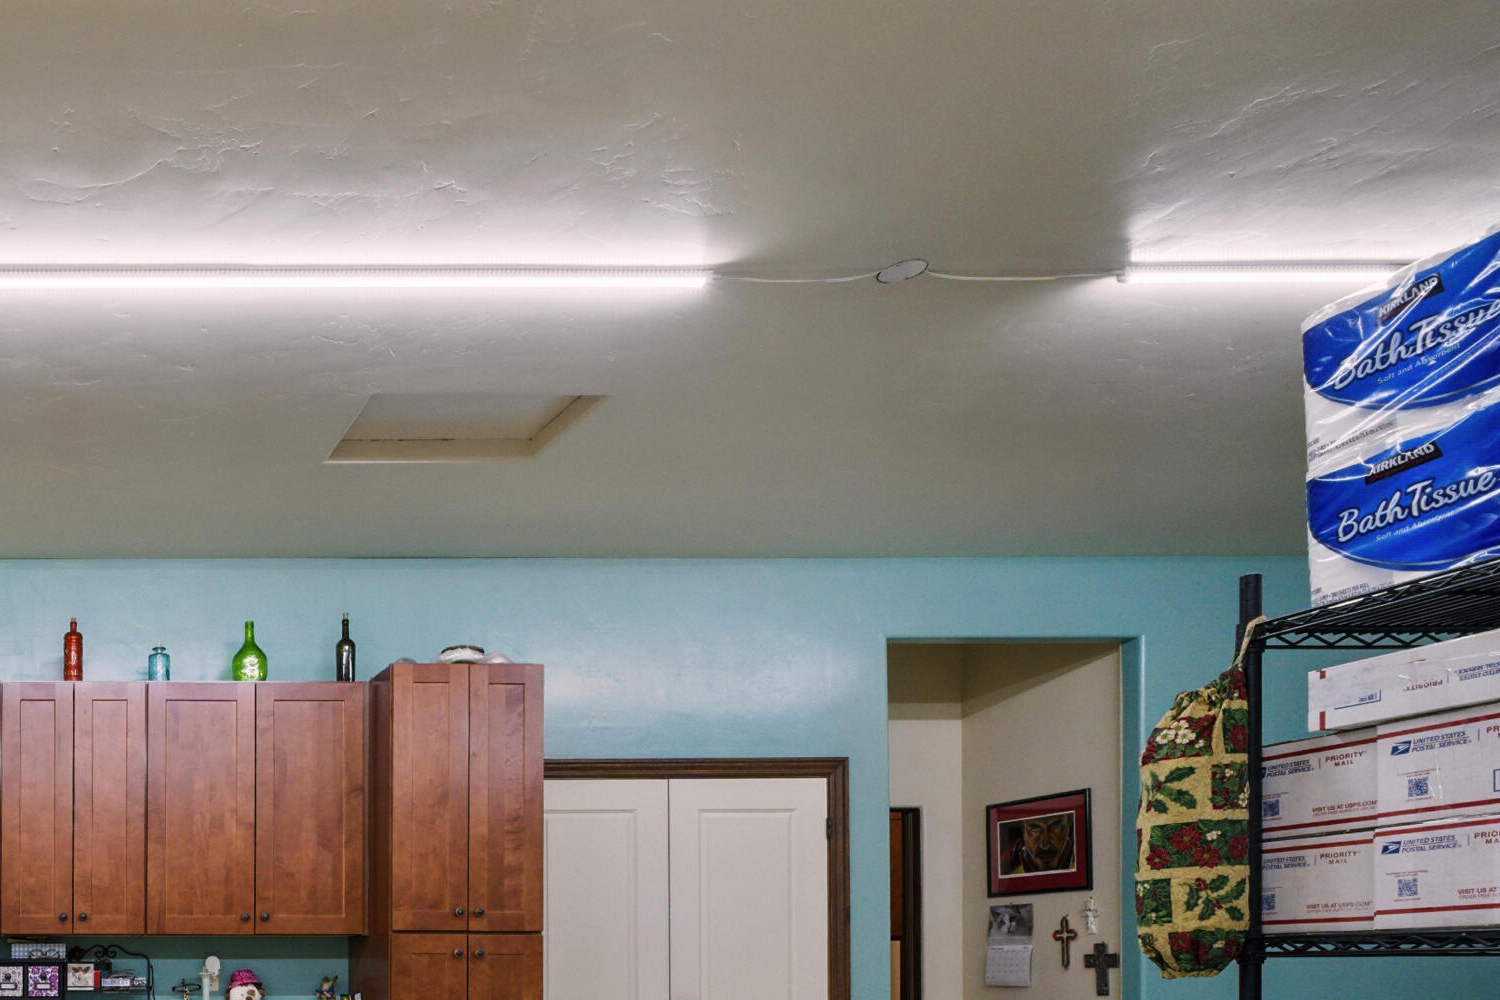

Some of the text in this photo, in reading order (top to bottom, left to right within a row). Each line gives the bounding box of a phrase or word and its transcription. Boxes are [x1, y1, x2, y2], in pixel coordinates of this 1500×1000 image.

[1379, 275, 1438, 317] KIRKLAND
[1377, 373, 1395, 385] Soft
[1397, 365, 1413, 376] and
[1369, 444, 1436, 477] KIRKLAND
[1338, 470, 1497, 543] Bath Tissue
[1413, 730, 1467, 745] UNITED STATES
[1411, 739, 1469, 753] POSTAL SERVICE
[1325, 751, 1363, 762] PRIORITY
[1403, 835, 1456, 846] UNITED STATES
[1320, 851, 1357, 860] PRIORITY
[1402, 843, 1457, 854] POSTAL SERVICE
[1457, 887, 1475, 895] VISIT
